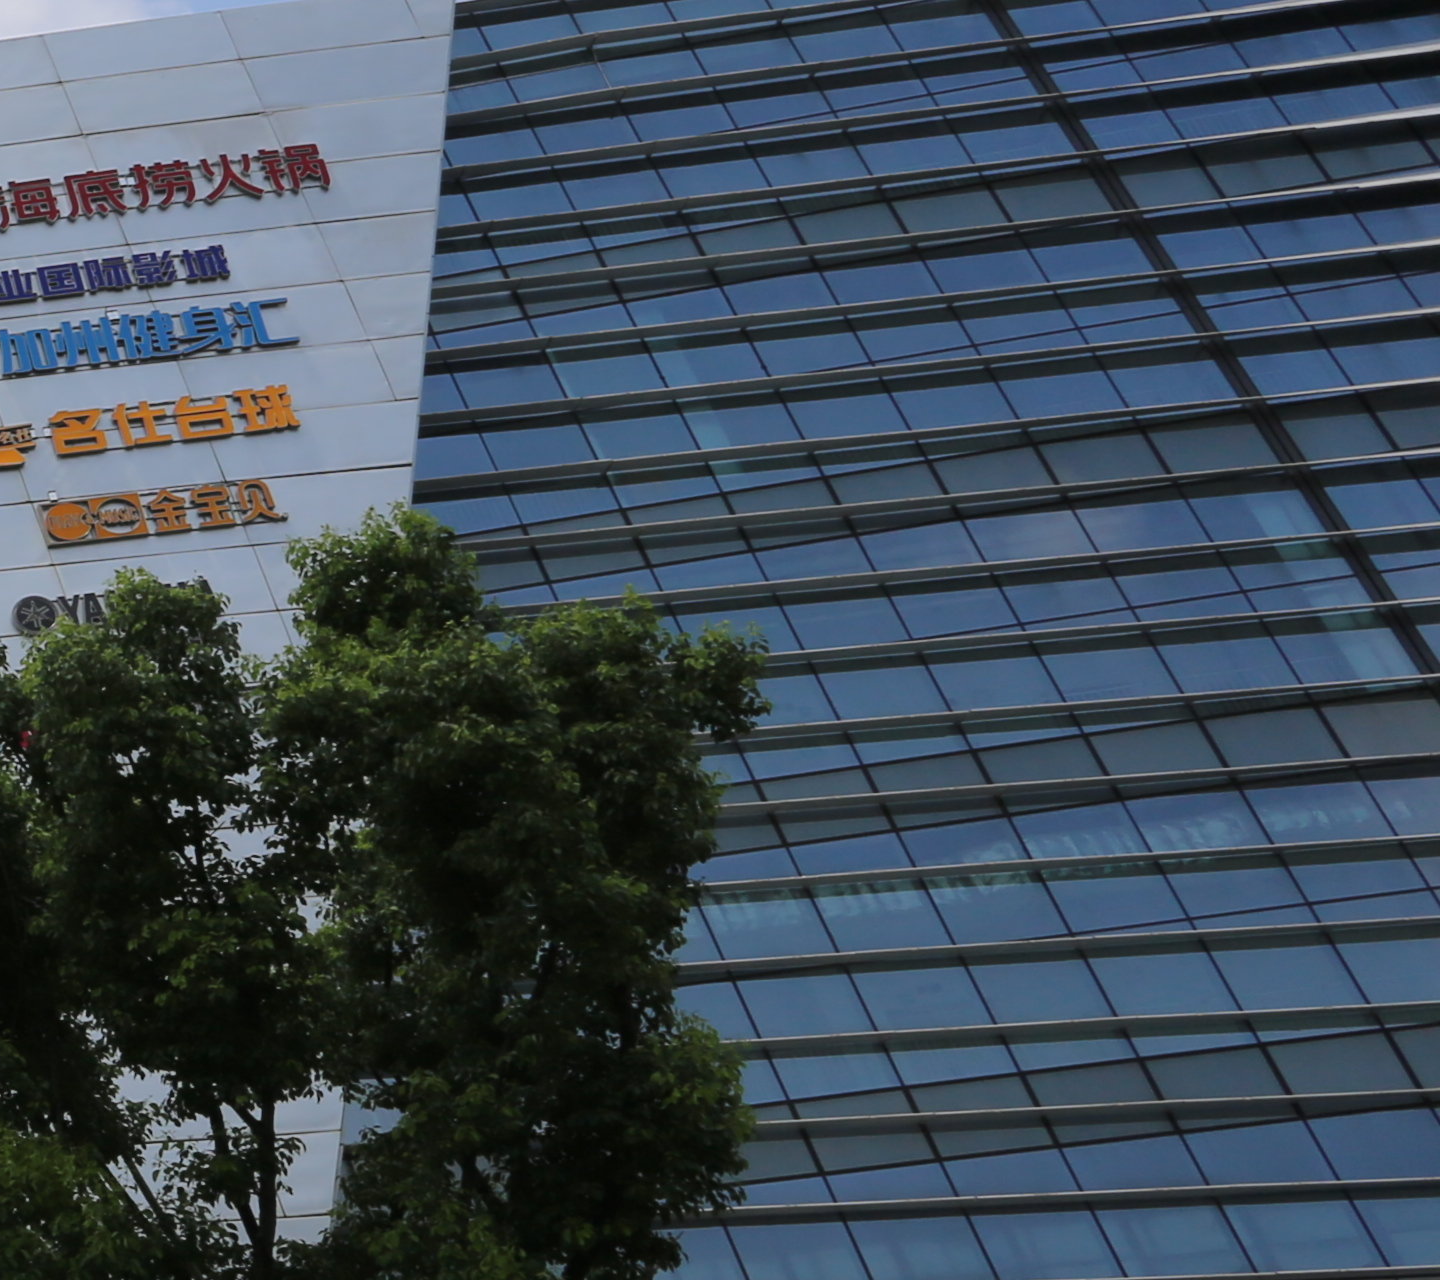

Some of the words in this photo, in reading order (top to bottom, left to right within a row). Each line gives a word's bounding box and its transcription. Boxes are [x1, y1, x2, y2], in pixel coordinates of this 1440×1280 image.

[49, 383, 301, 457] 名仕台球
[148, 479, 287, 532] 金宝贝
